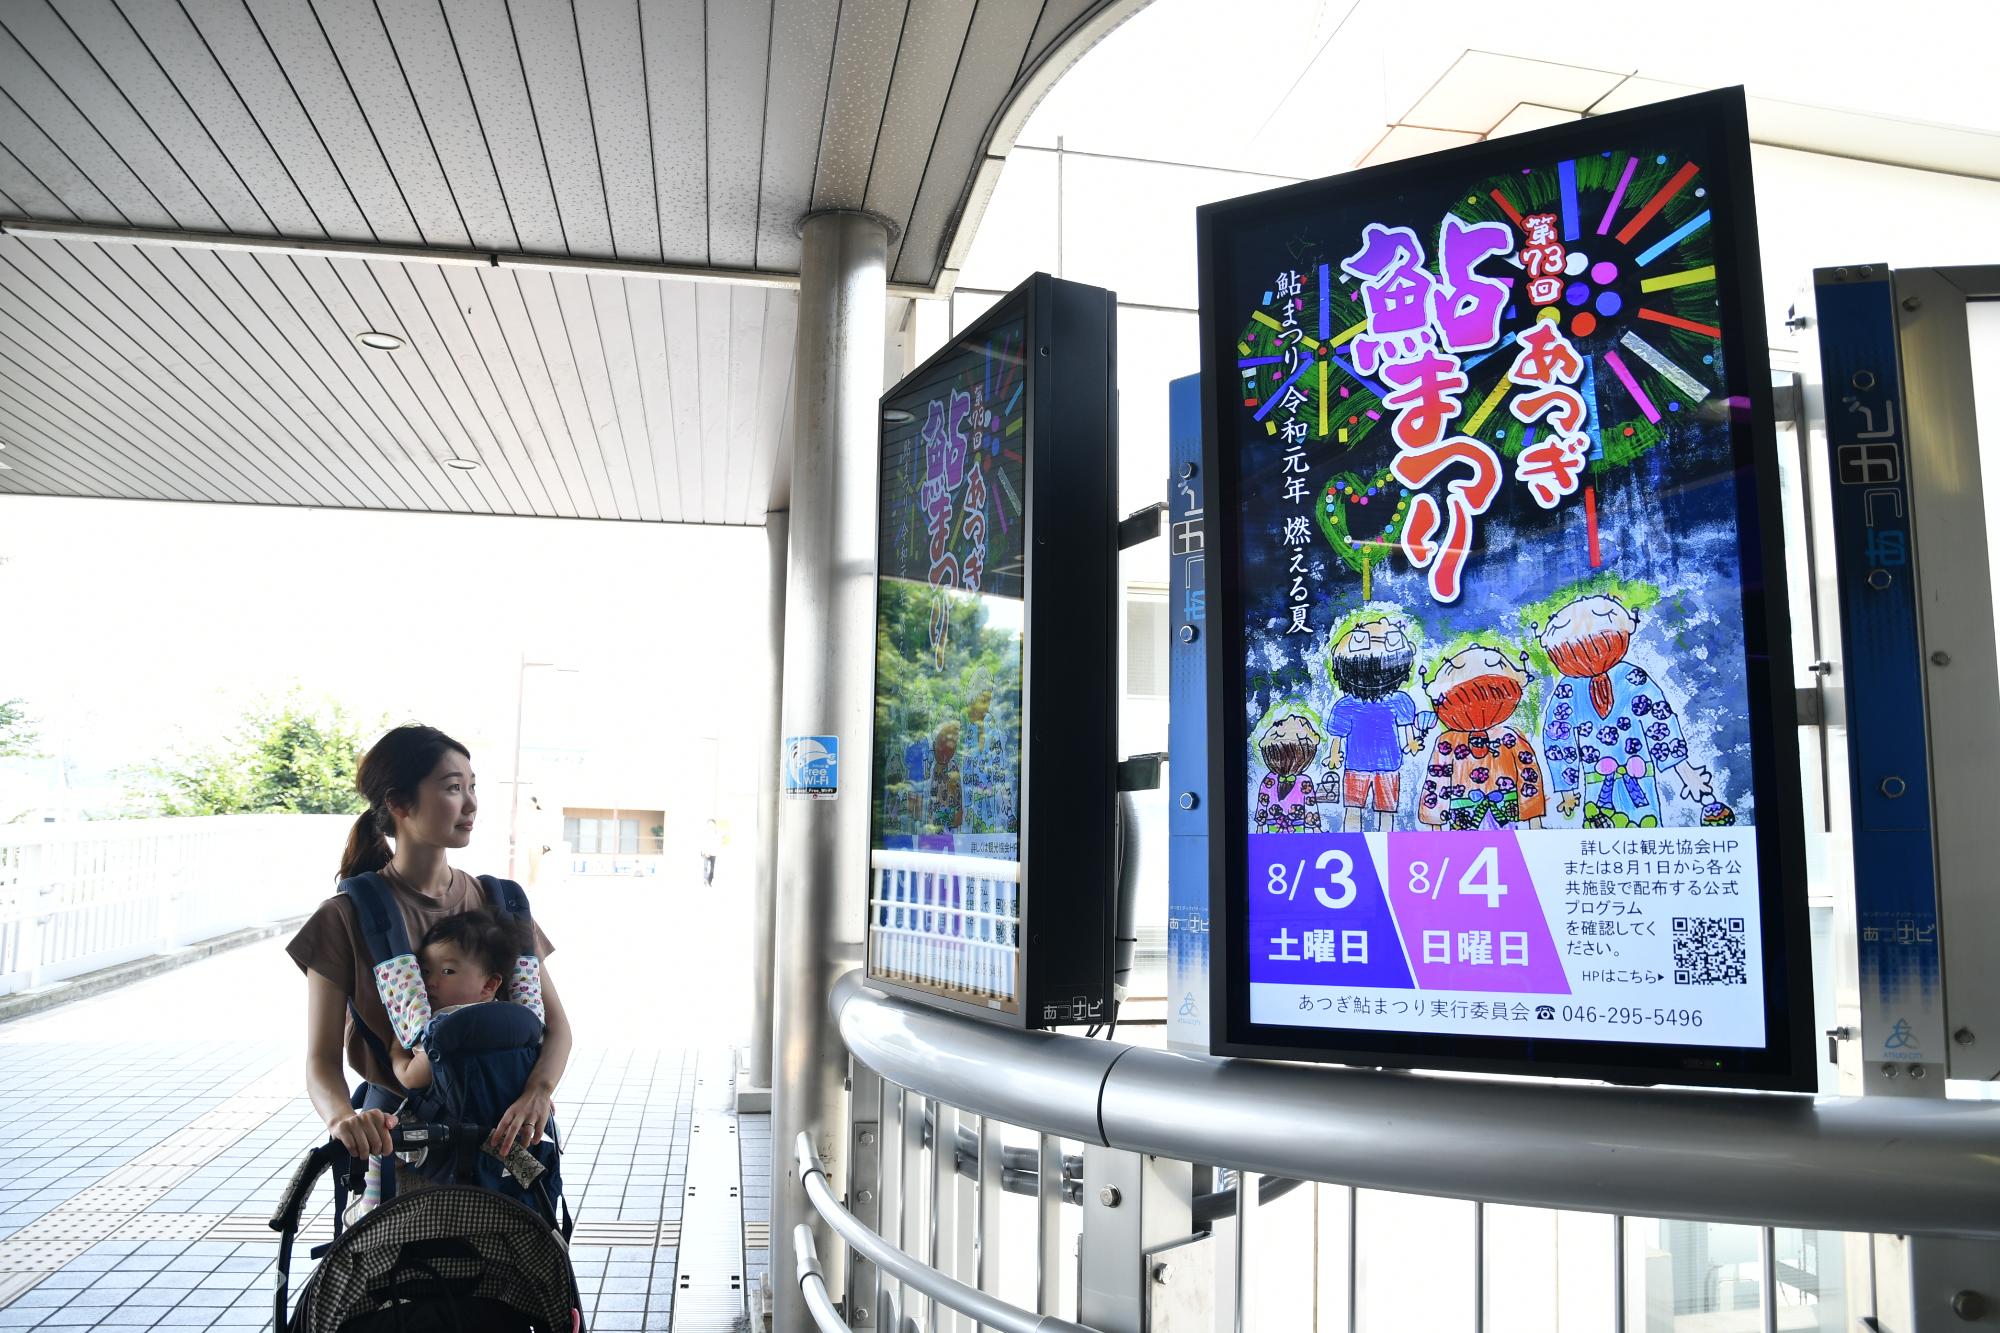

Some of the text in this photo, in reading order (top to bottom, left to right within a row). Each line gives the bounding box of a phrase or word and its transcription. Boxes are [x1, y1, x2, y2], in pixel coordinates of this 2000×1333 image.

[1519, 213, 1566, 305] 第73回
[1341, 213, 1513, 602] 鮎まつり
[1509, 319, 1590, 508] あつぎ
[1275, 270, 1314, 634] 鮎まつり 令和元年 燃える夏
[963, 461, 986, 593] あつぎ
[804, 767, 827, 775] Free
[1267, 849, 1357, 909] 8/3
[1408, 847, 1508, 908] 8/4
[1565, 880, 1739, 896] 共施設で配布する公式
[1565, 900, 1643, 916] プログラム
[1268, 927, 1369, 965] 土曜日
[1566, 920, 1656, 937] を確認してく
[1422, 930, 1529, 967] 日曜日
[1567, 940, 1620, 957] ださい。
[1299, 994, 1703, 1027] あつぎ鮎まつり実行委員会 046-295-5496
